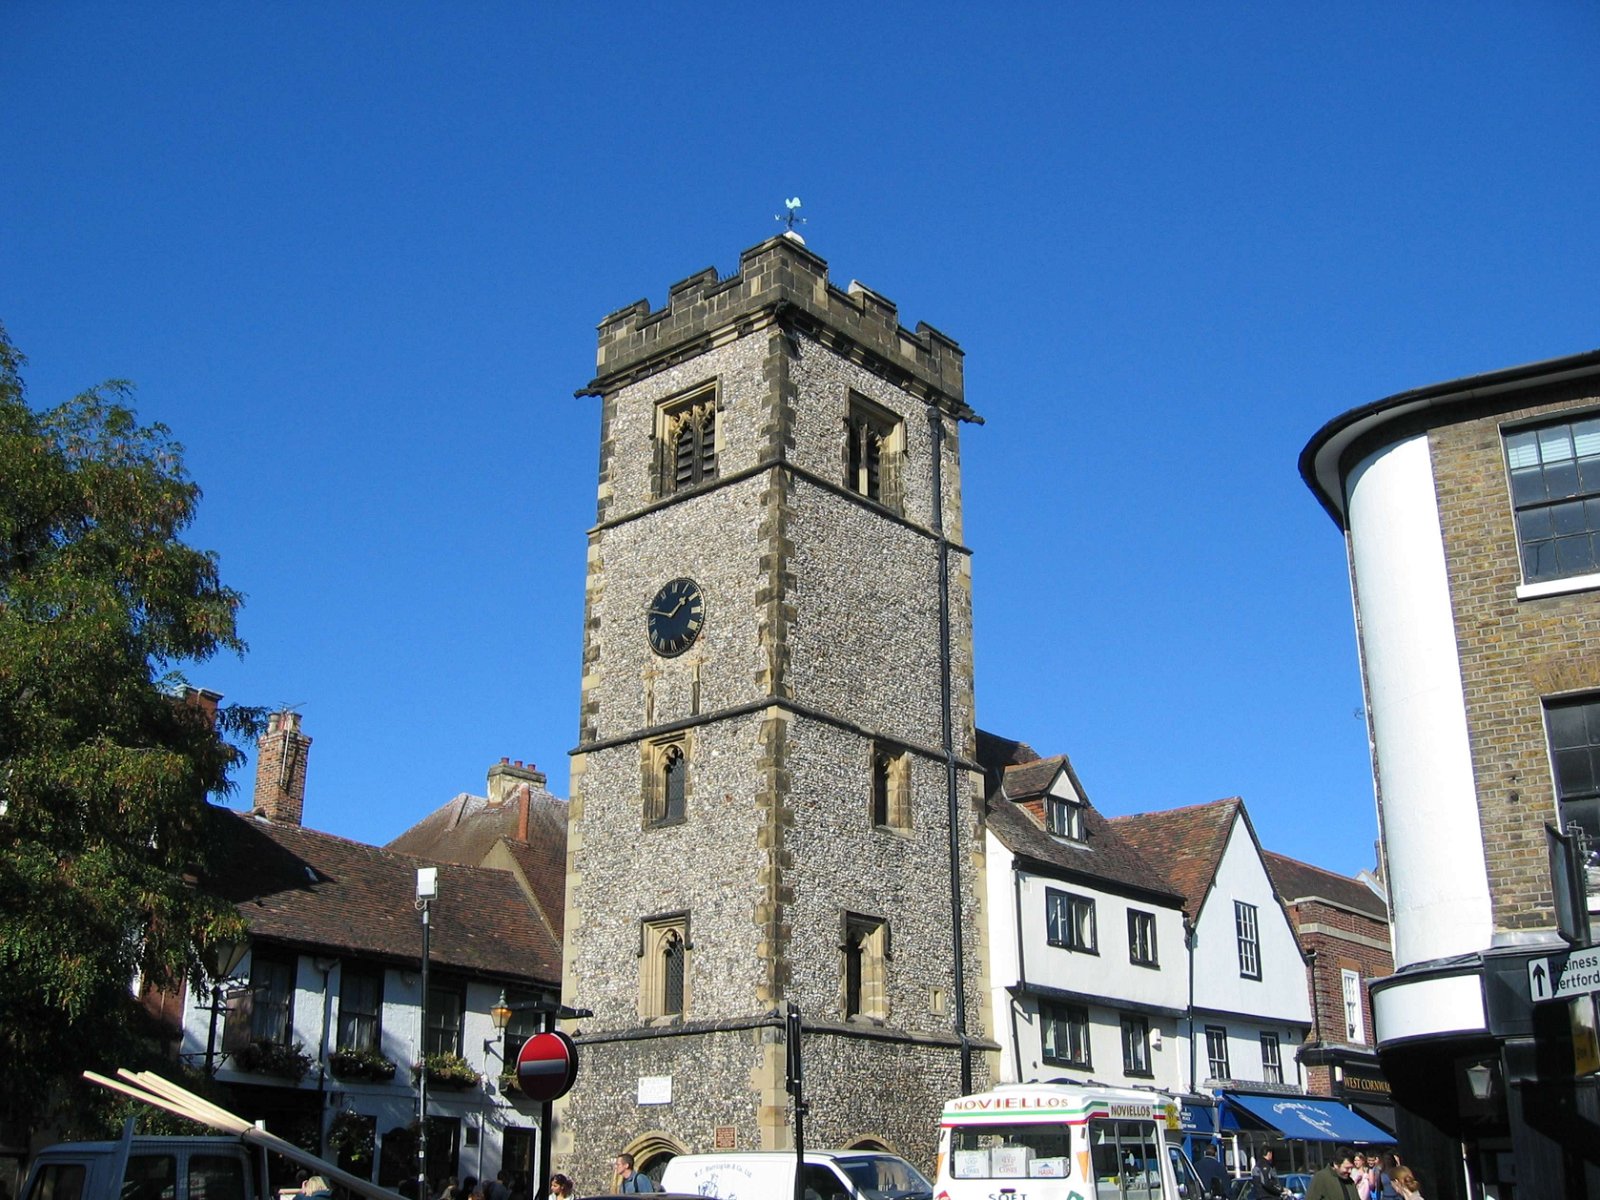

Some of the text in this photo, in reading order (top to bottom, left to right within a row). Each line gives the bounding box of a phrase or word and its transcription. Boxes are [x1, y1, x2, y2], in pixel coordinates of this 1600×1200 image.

[1556, 969, 1600, 989] ertford
[1344, 1076, 1361, 1089] WEST
[954, 1097, 1069, 1110] NOVIELLOS
[1111, 1105, 1150, 1117] NOVIELLOS
